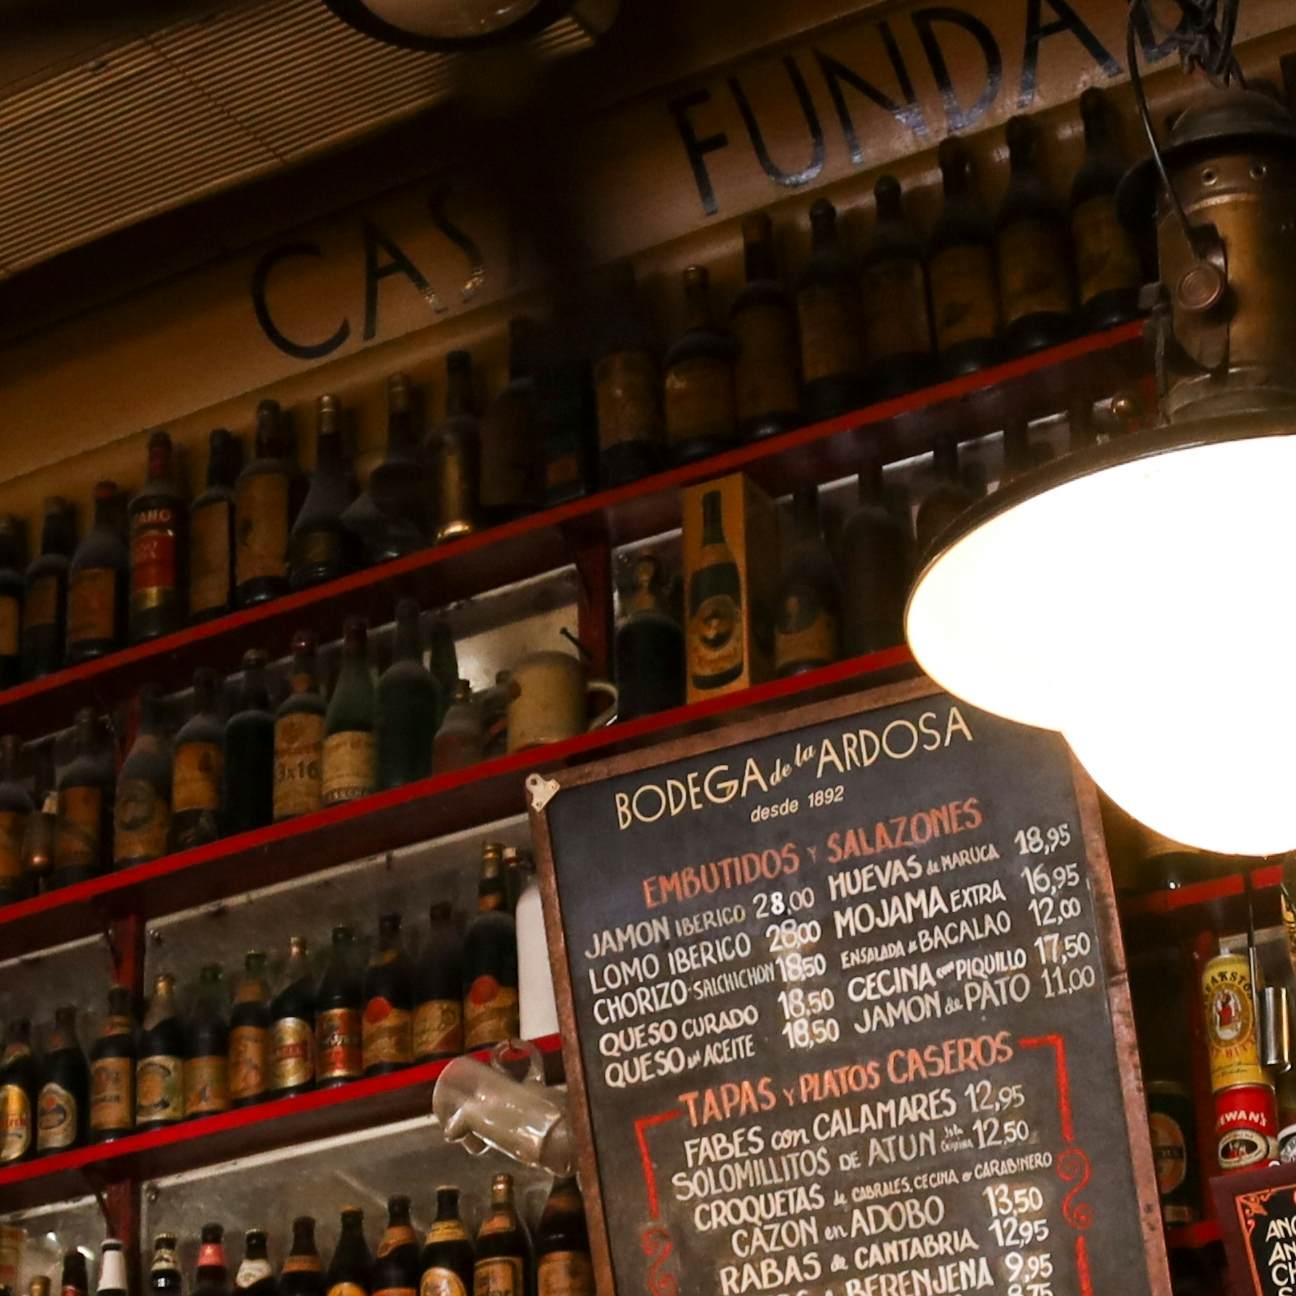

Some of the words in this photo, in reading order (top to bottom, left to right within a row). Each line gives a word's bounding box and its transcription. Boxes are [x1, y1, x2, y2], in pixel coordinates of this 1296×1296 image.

[615, 757, 769, 830] BODEGA
[769, 758, 793, 787] de
[809, 706, 973, 779] ARDOSA
[750, 798, 799, 823] desde
[807, 785, 845, 808] 1892
[642, 842, 800, 909] EMBUTIDOS
[827, 796, 983, 864] SALAZONES
[584, 915, 671, 960] JAMON
[675, 904, 747, 938] IBERICO
[833, 886, 949, 939] MOJAMA
[950, 879, 1007, 913] EXTRA
[1020, 862, 1080, 895] 16,95
[588, 953, 660, 995] LOMO
[667, 931, 752, 975] IBERICO
[678, 1076, 777, 1128] TAPAS
[799, 1060, 881, 1104] PLATOS
[886, 1030, 1014, 1084] CASEROS
[684, 1125, 765, 1169] FABES
[812, 1088, 957, 1142] CALAMARES
[964, 1079, 1025, 1113] 12,95
[731, 1216, 819, 1258] CAZON
[850, 1195, 945, 1239] ADOBO
[1004, 1251, 1053, 1284] 9,95
